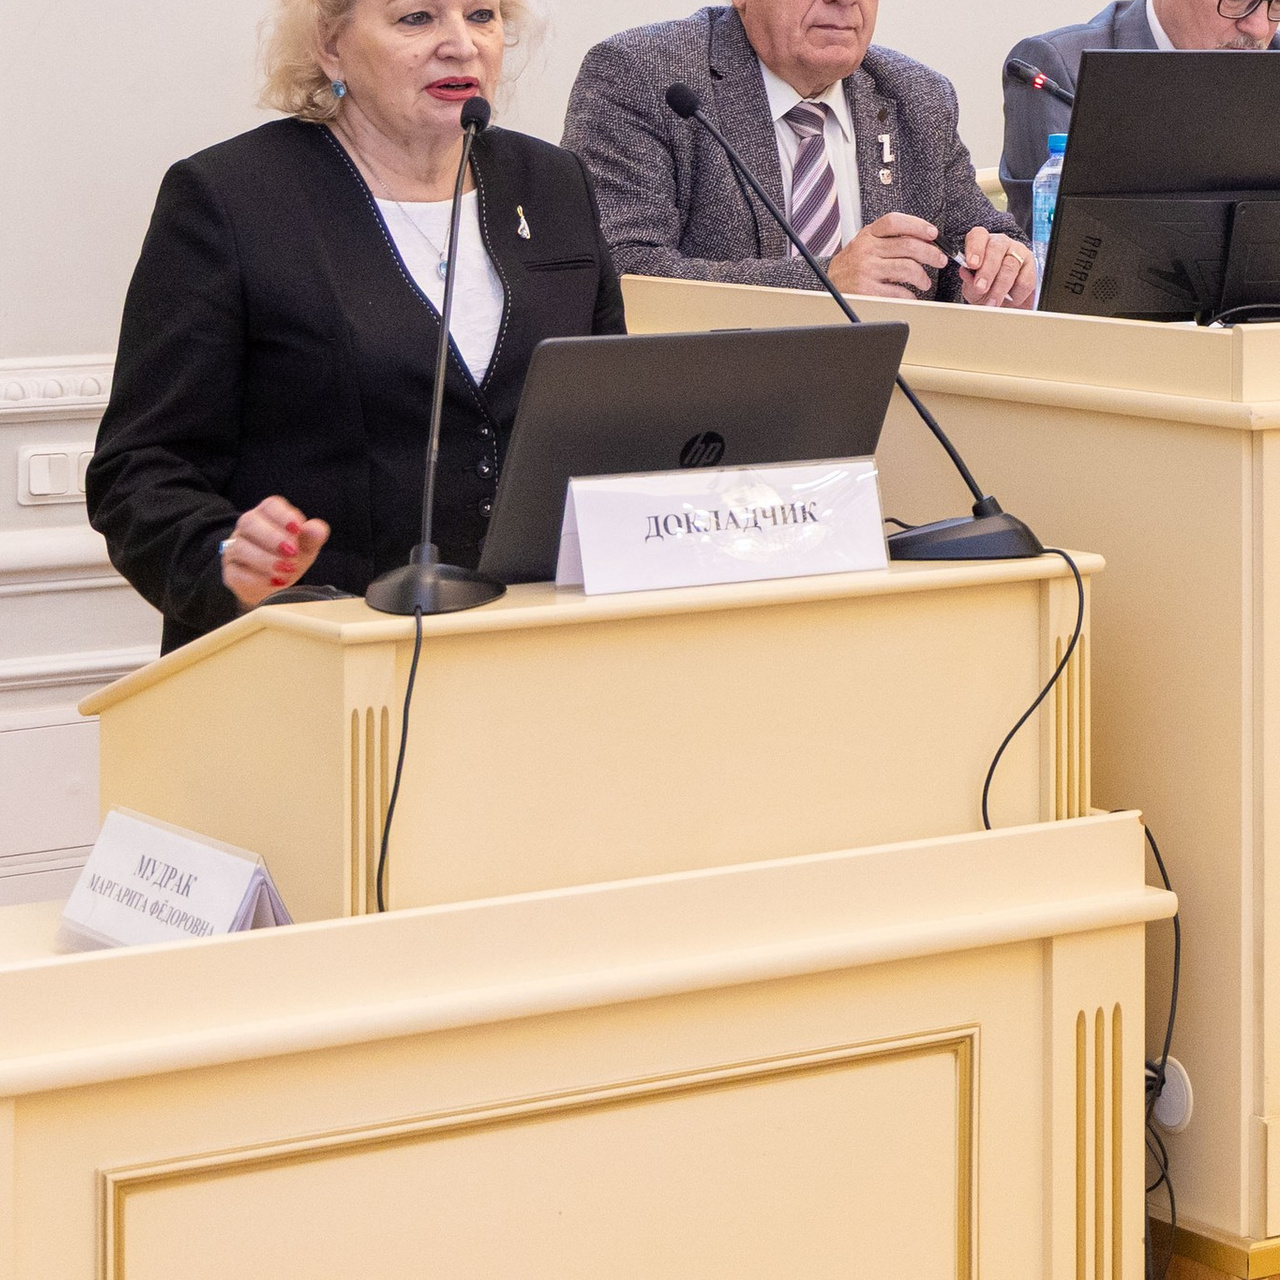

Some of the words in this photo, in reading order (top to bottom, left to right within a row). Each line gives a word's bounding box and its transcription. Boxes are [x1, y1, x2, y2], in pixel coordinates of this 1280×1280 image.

[683, 434, 723, 467] hp
[644, 501, 820, 543] ДОКЛАДЧИК
[86, 873, 149, 914] МАРГАРИТА
[133, 854, 198, 898] МУДРАК
